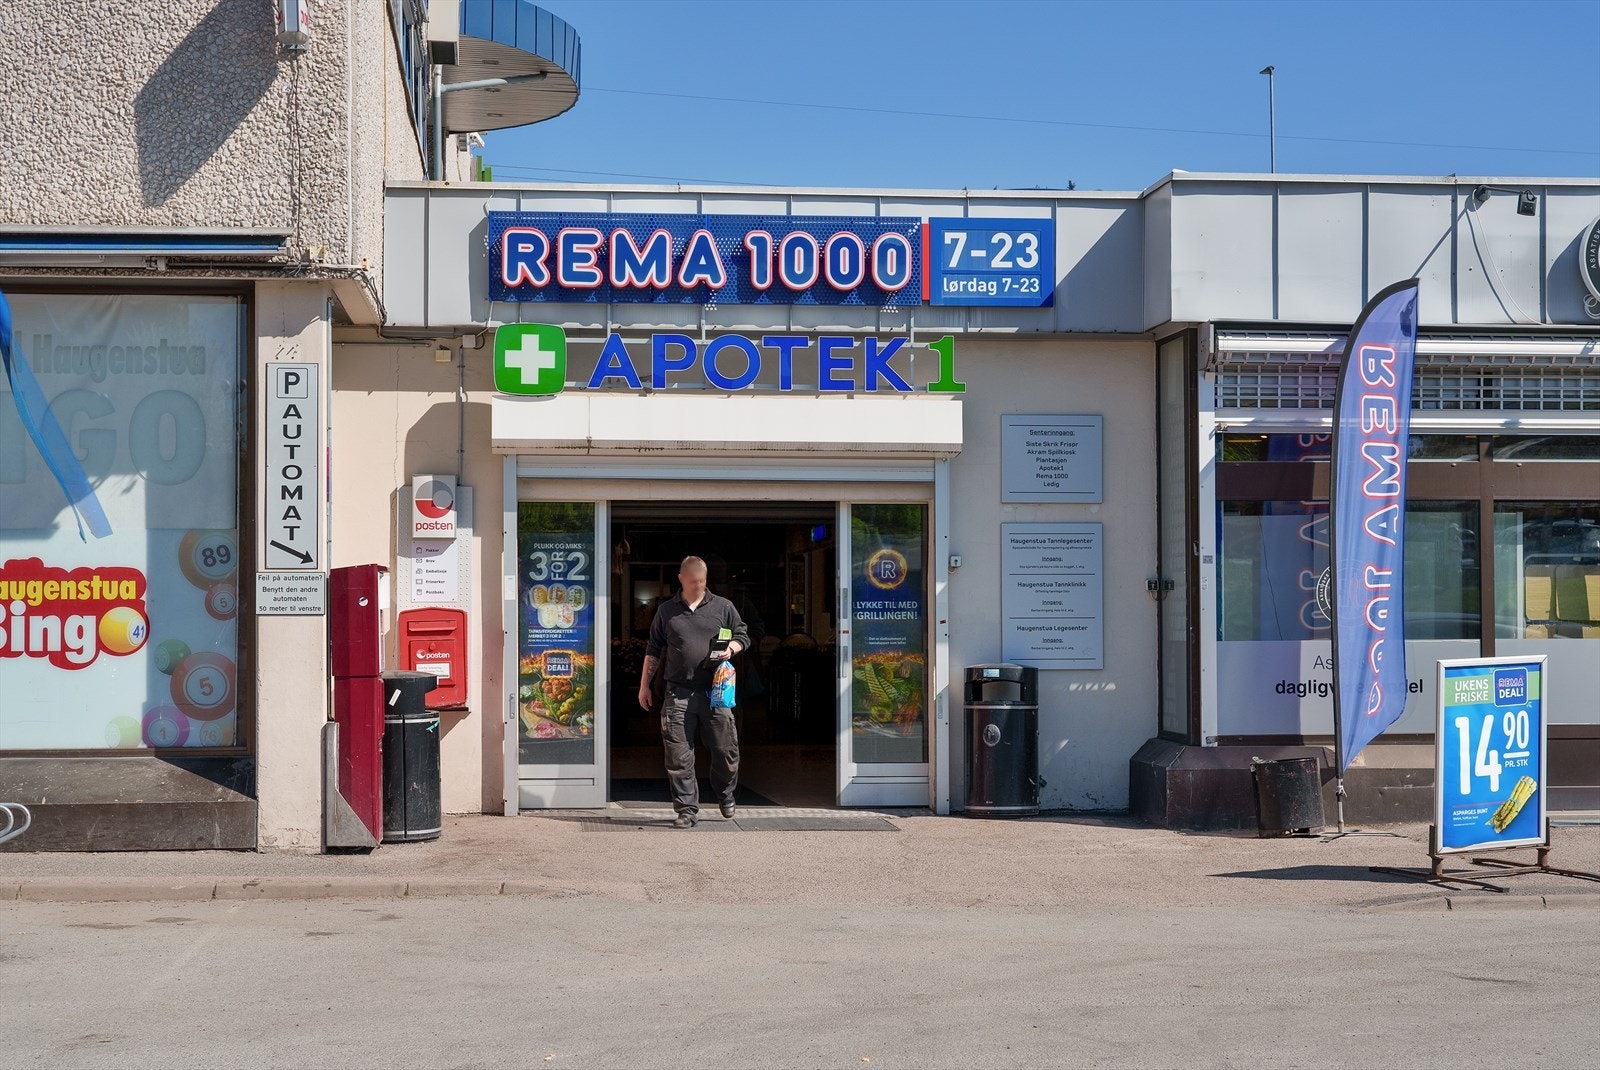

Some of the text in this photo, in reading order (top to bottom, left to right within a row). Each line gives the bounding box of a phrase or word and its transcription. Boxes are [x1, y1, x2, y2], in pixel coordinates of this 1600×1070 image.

[943, 231, 1040, 269] 7-23
[502, 227, 912, 291] REMA 1000
[943, 277, 1040, 296] lørdag 7-23
[33, 332, 206, 383] Haugenstua
[586, 333, 914, 392] APOTEK
[284, 371, 301, 394] P
[1358, 344, 1402, 546] REMA
[415, 521, 453, 532] posten
[201, 545, 231, 568] 89
[529, 551, 586, 580] 3 FOR 2
[882, 560, 896, 578] R
[262, 586, 283, 594] Benytt
[1017, 581, 1053, 589] Haugenstua
[218, 598, 228, 607] 5
[856, 601, 918, 609] LYKKE TIL MED
[856, 611, 918, 620] GRILLINGEN!
[132, 625, 145, 639] 41
[1017, 625, 1088, 633] Haugenstua Legesenter
[426, 651, 450, 659] posten
[200, 677, 214, 696] 5
[1455, 679, 1489, 692] UKENS
[1498, 677, 1524, 687] REMA
[1455, 690, 1489, 703] FRISKE
[1499, 688, 1524, 699] DEAL!
[1455, 710, 1530, 795] 14 90
[1505, 760, 1516, 768] PR.
